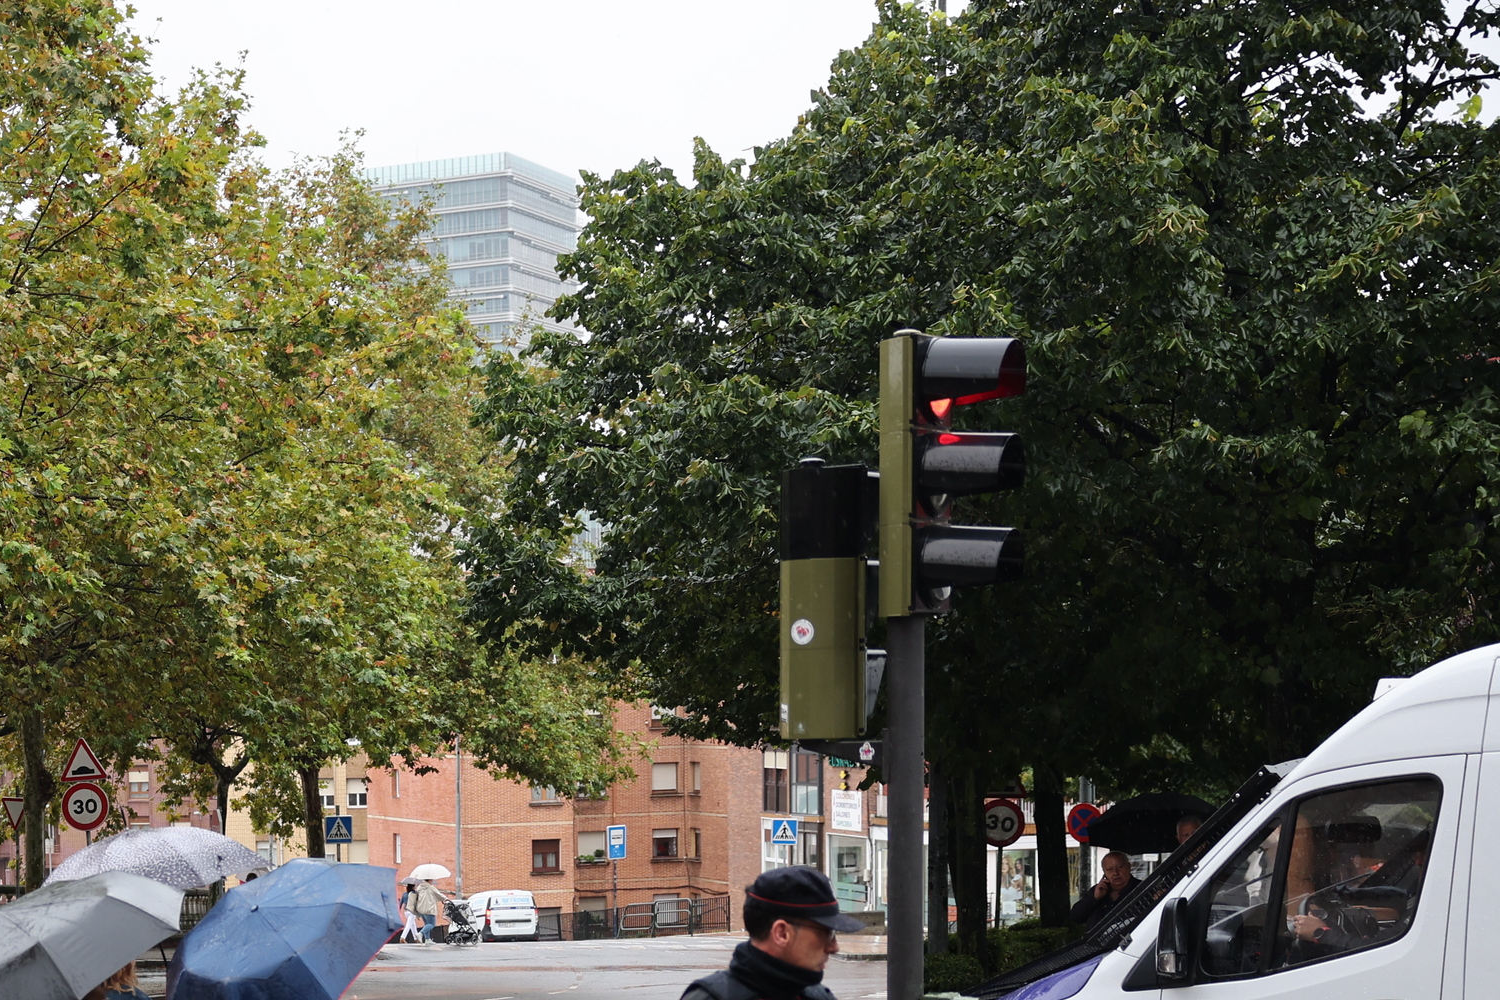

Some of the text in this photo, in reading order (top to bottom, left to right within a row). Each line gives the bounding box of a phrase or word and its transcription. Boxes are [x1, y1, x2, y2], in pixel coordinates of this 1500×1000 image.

[73, 798, 98, 815] 30
[835, 810, 851, 819] SALONES
[986, 814, 1015, 833] 30
